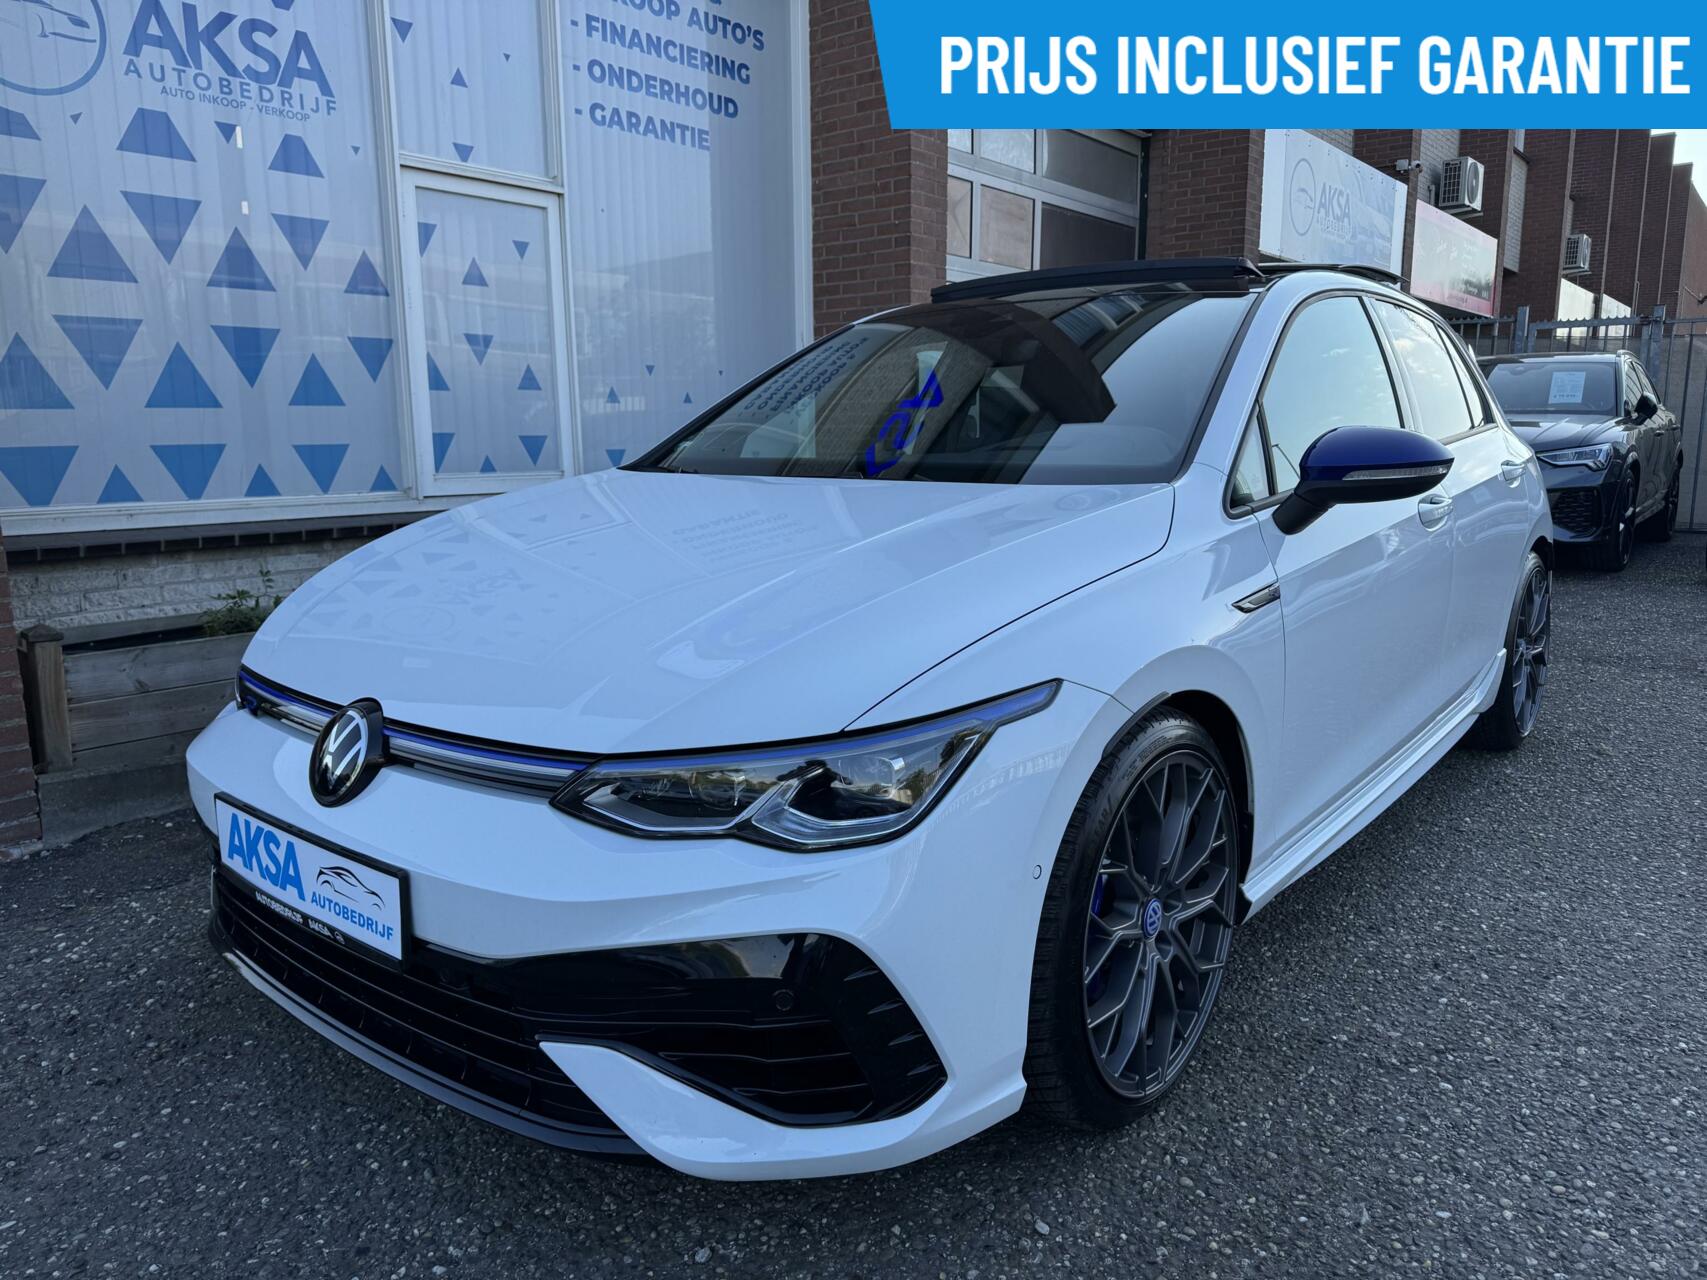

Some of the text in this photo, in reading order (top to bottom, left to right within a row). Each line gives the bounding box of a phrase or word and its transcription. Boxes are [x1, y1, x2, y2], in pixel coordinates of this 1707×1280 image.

[122, 0, 335, 98] AKSA
[585, 13, 750, 85] FINANCIERING
[687, 7, 765, 51] AUTO'S
[123, 58, 337, 116] AUTOBEDRIJF
[160, 86, 198, 102] AUTO
[199, 92, 247, 110] INKOOP
[256, 104, 311, 122] VERKOOP
[587, 59, 739, 119] ONDERHOUD
[589, 102, 711, 151] GARANTIE
[1317, 182, 1351, 226] AKSA
[228, 812, 306, 902] AKSA
[311, 891, 394, 941] AUTOBEDRIJF
